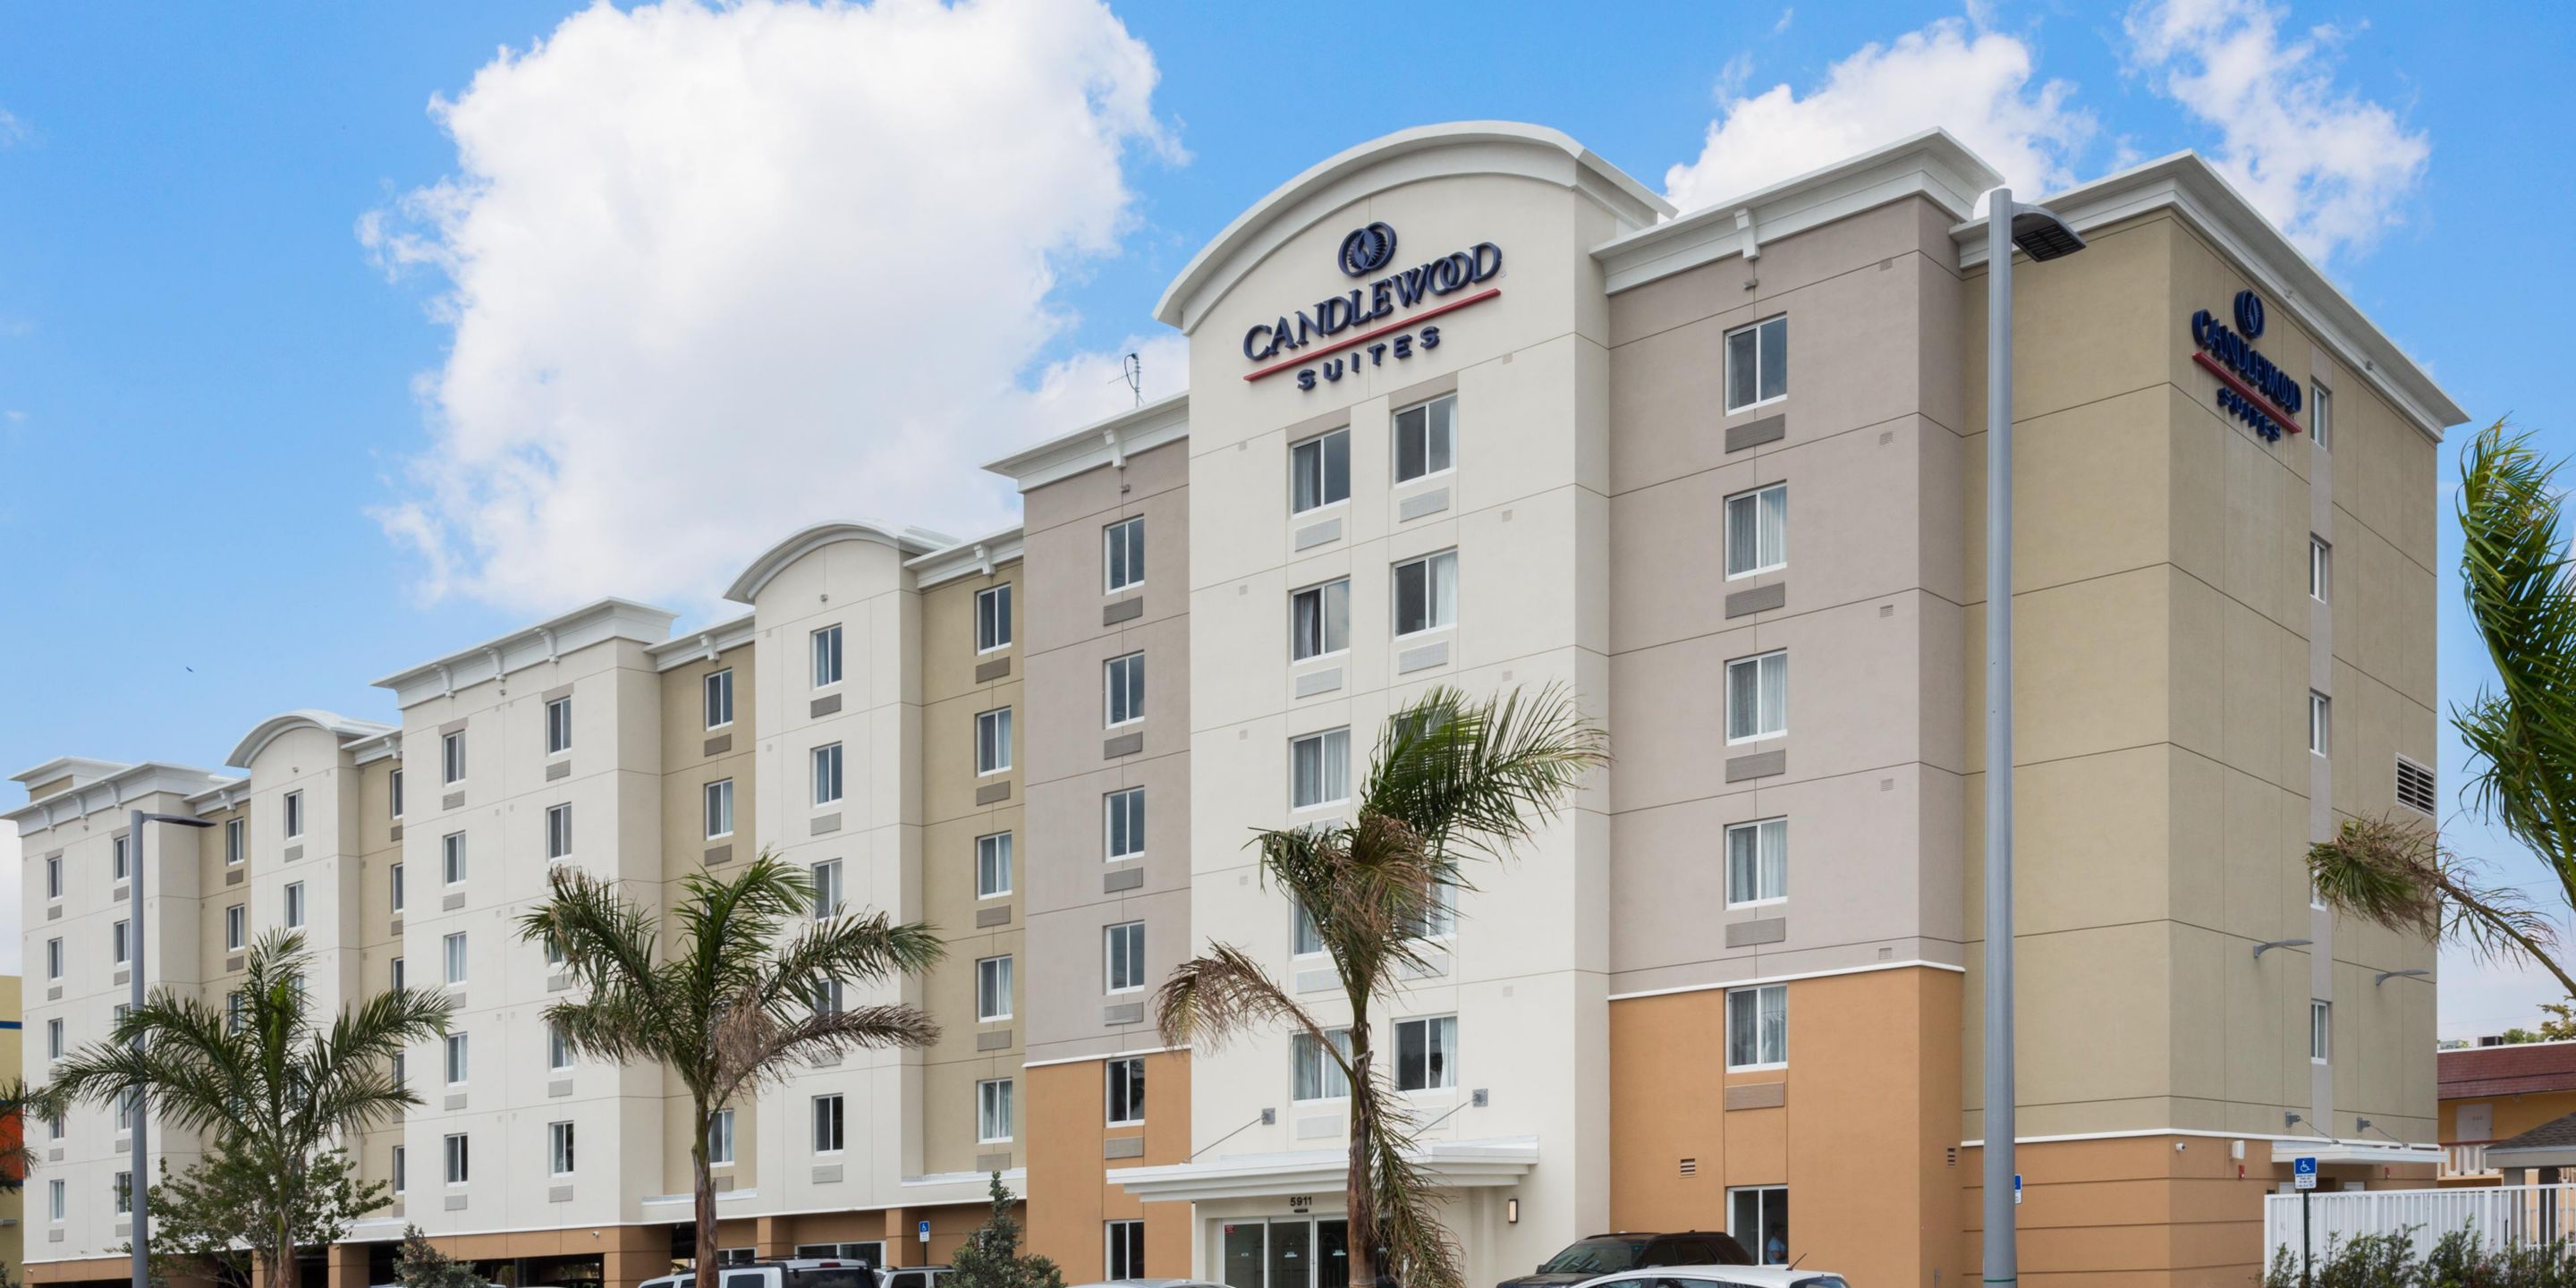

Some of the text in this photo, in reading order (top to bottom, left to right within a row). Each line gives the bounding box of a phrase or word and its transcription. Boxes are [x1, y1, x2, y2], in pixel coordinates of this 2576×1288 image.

[1243, 242, 1503, 360] CANDLEWOOD
[1297, 326, 1440, 391] SUITES
[2192, 309, 2302, 414] CANDLEWOOD
[2217, 386, 2281, 442] SUITES
[1290, 1196, 1312, 1207] 5911
